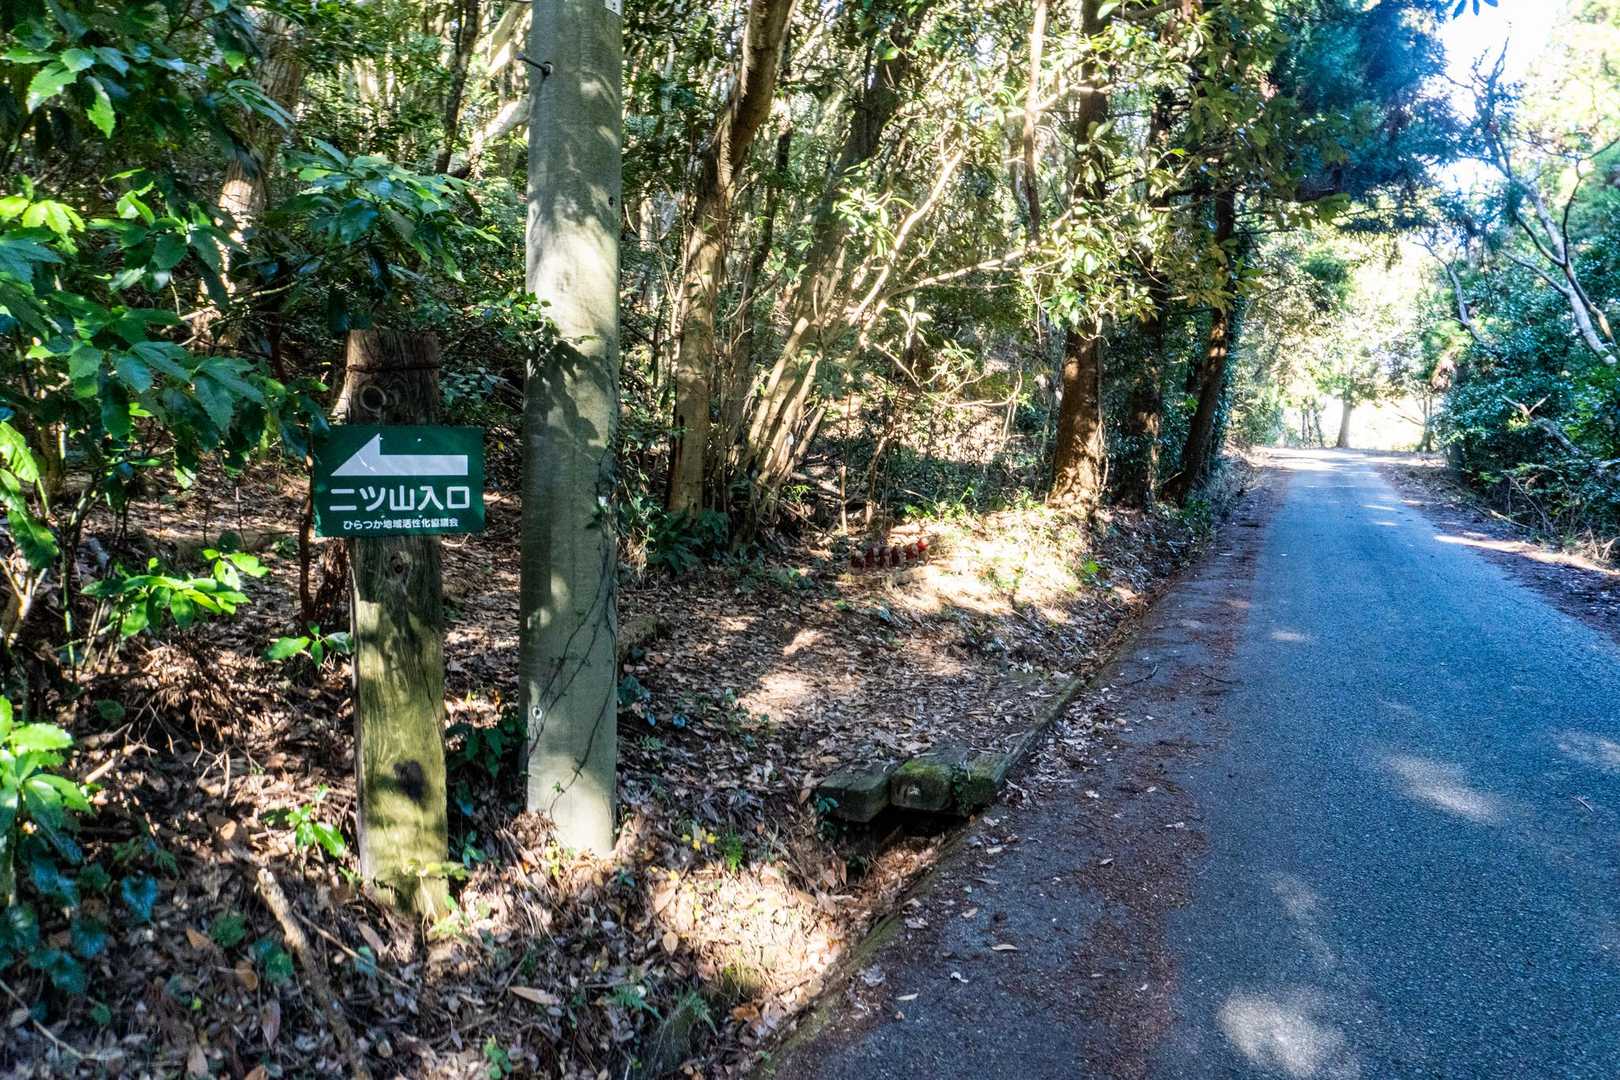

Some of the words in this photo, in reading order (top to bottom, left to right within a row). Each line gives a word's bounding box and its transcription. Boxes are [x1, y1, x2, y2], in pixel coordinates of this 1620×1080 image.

[329, 485, 470, 512] 二ツ山入口
[343, 518, 460, 530] ひらつか地域活性化協議会
